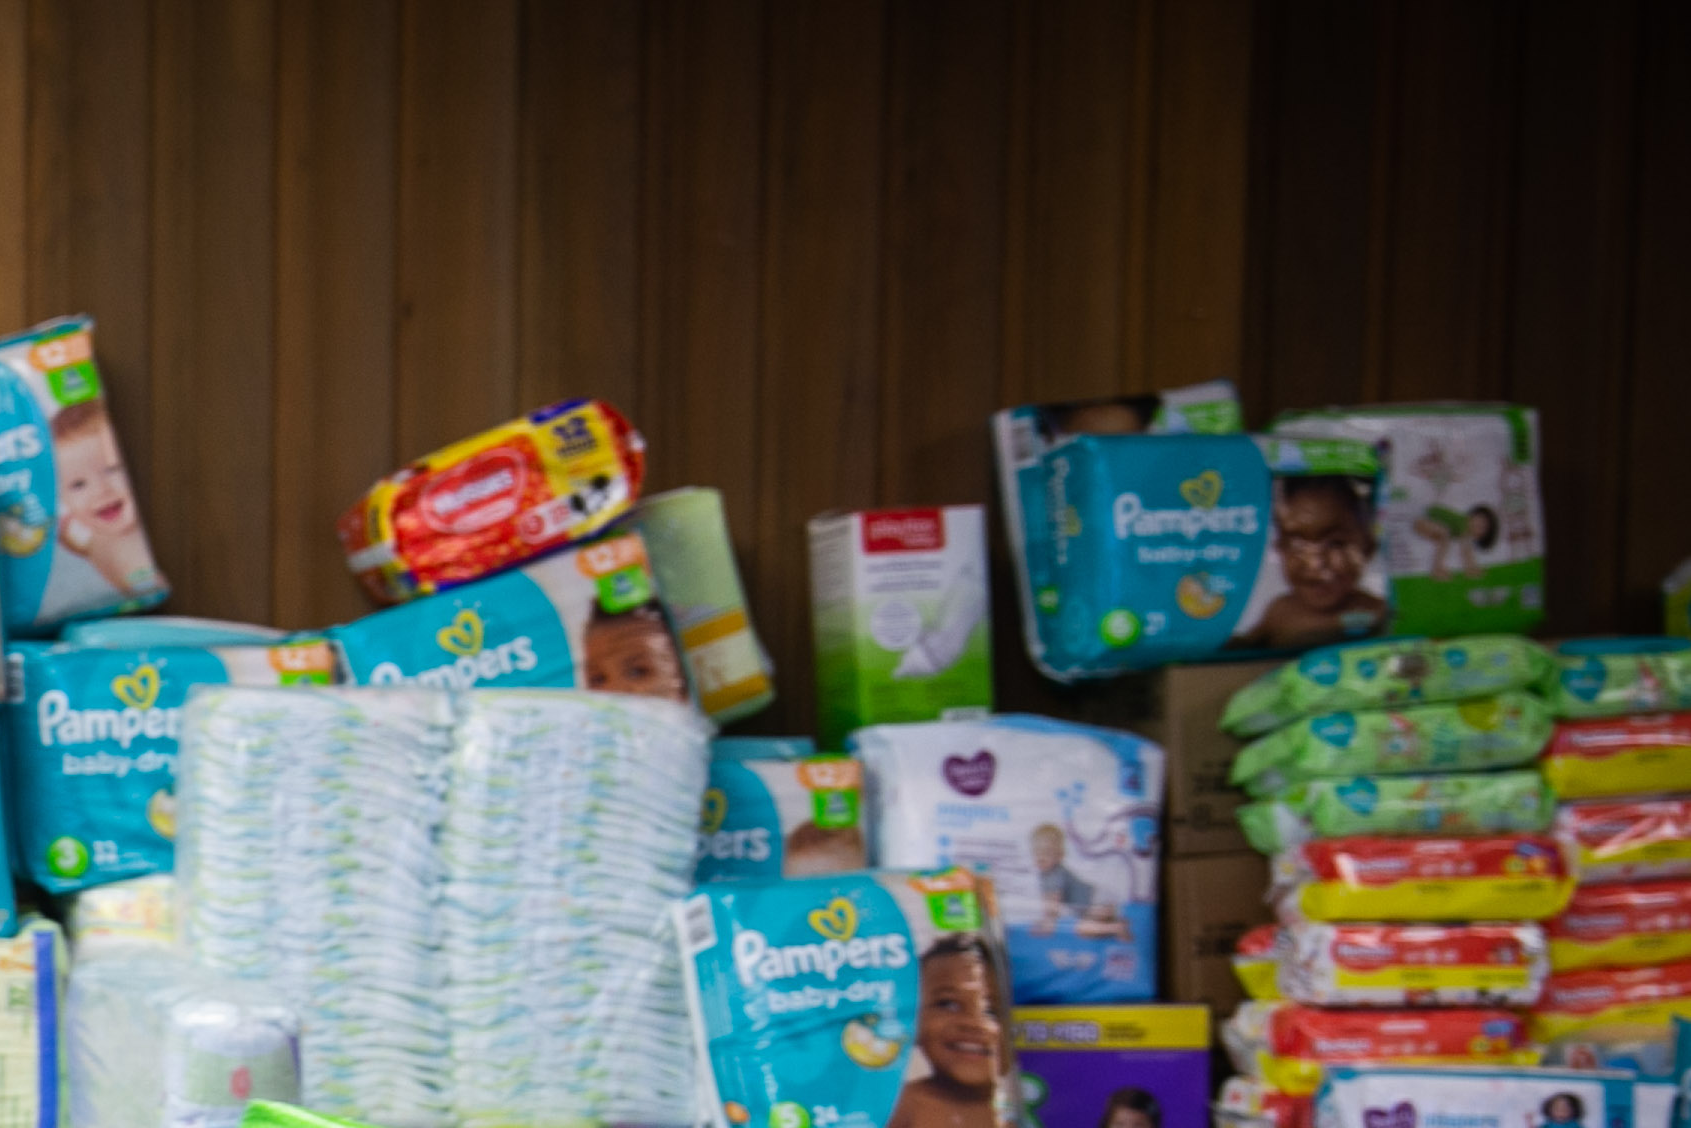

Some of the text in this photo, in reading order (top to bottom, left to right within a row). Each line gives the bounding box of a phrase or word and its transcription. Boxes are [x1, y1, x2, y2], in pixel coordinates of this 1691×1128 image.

[1113, 492, 1259, 540] Pampers
[1137, 544, 1241, 565] baby-dry
[37, 690, 180, 747] Pamper
[55, 837, 80, 868] 3
[733, 928, 909, 986] Pampers
[768, 979, 895, 1013] baby-dry
